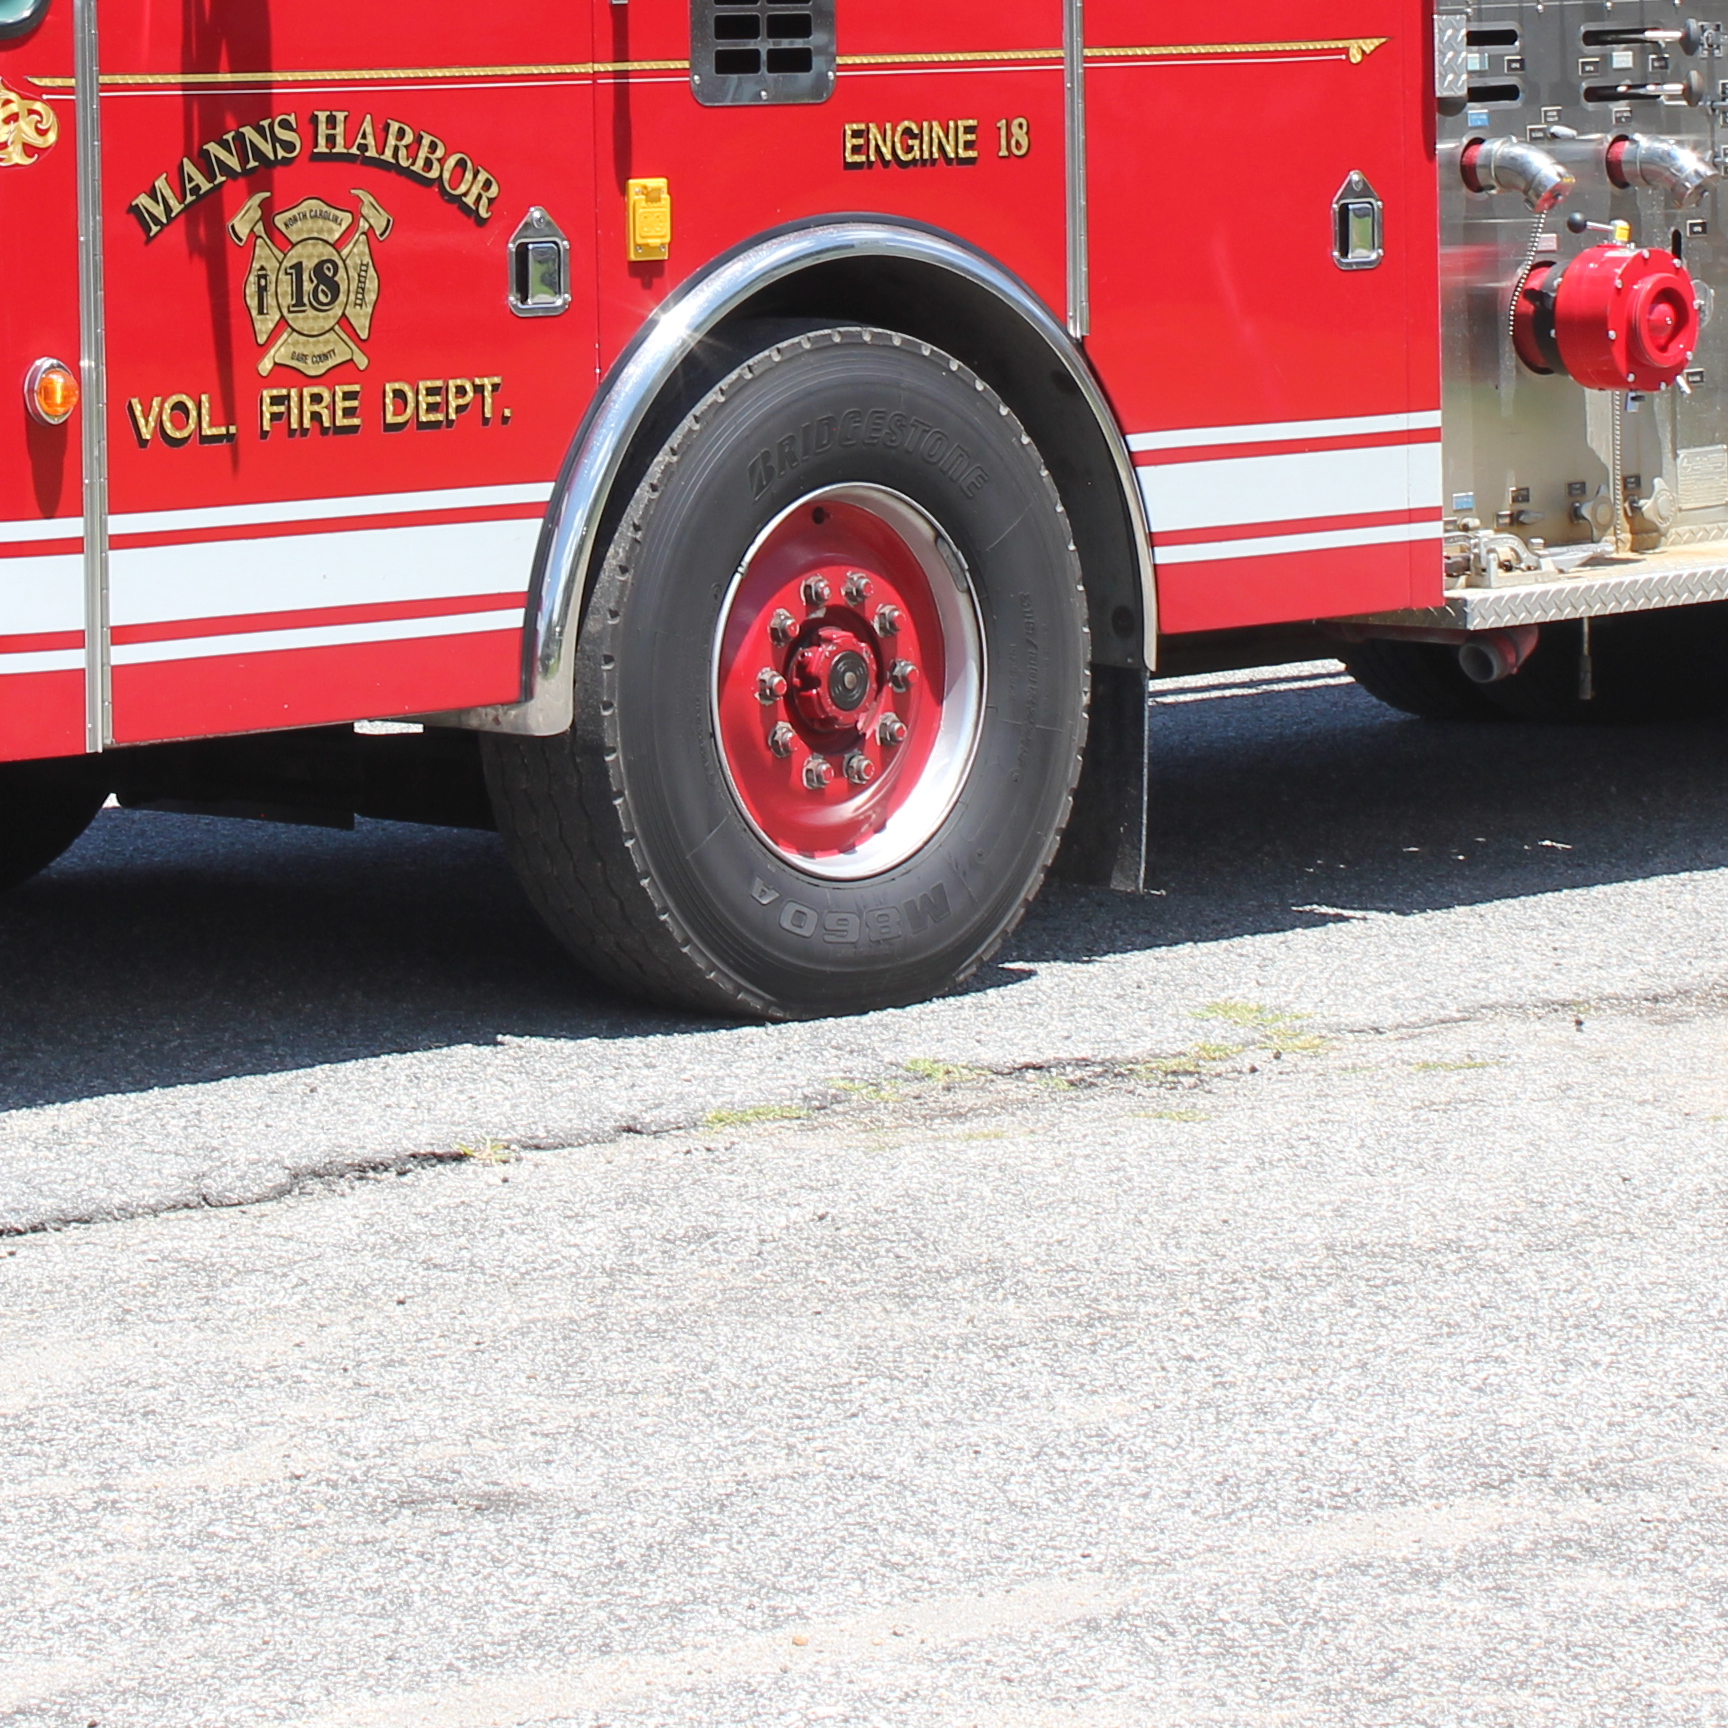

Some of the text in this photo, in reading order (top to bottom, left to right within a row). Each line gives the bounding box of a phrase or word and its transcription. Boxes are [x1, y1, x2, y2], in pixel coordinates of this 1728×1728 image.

[843, 117, 1030, 170] ENGINE 18
[128, 110, 501, 245] MANNS HARBOR
[283, 208, 343, 230] NORTH CAROLINA
[285, 258, 340, 313] 18
[311, 347, 337, 365] COUNTY
[127, 376, 512, 449] VOL. FIRE DEPT.
[747, 408, 990, 504] BRIDGESTONE
[750, 875, 952, 944] M860A
